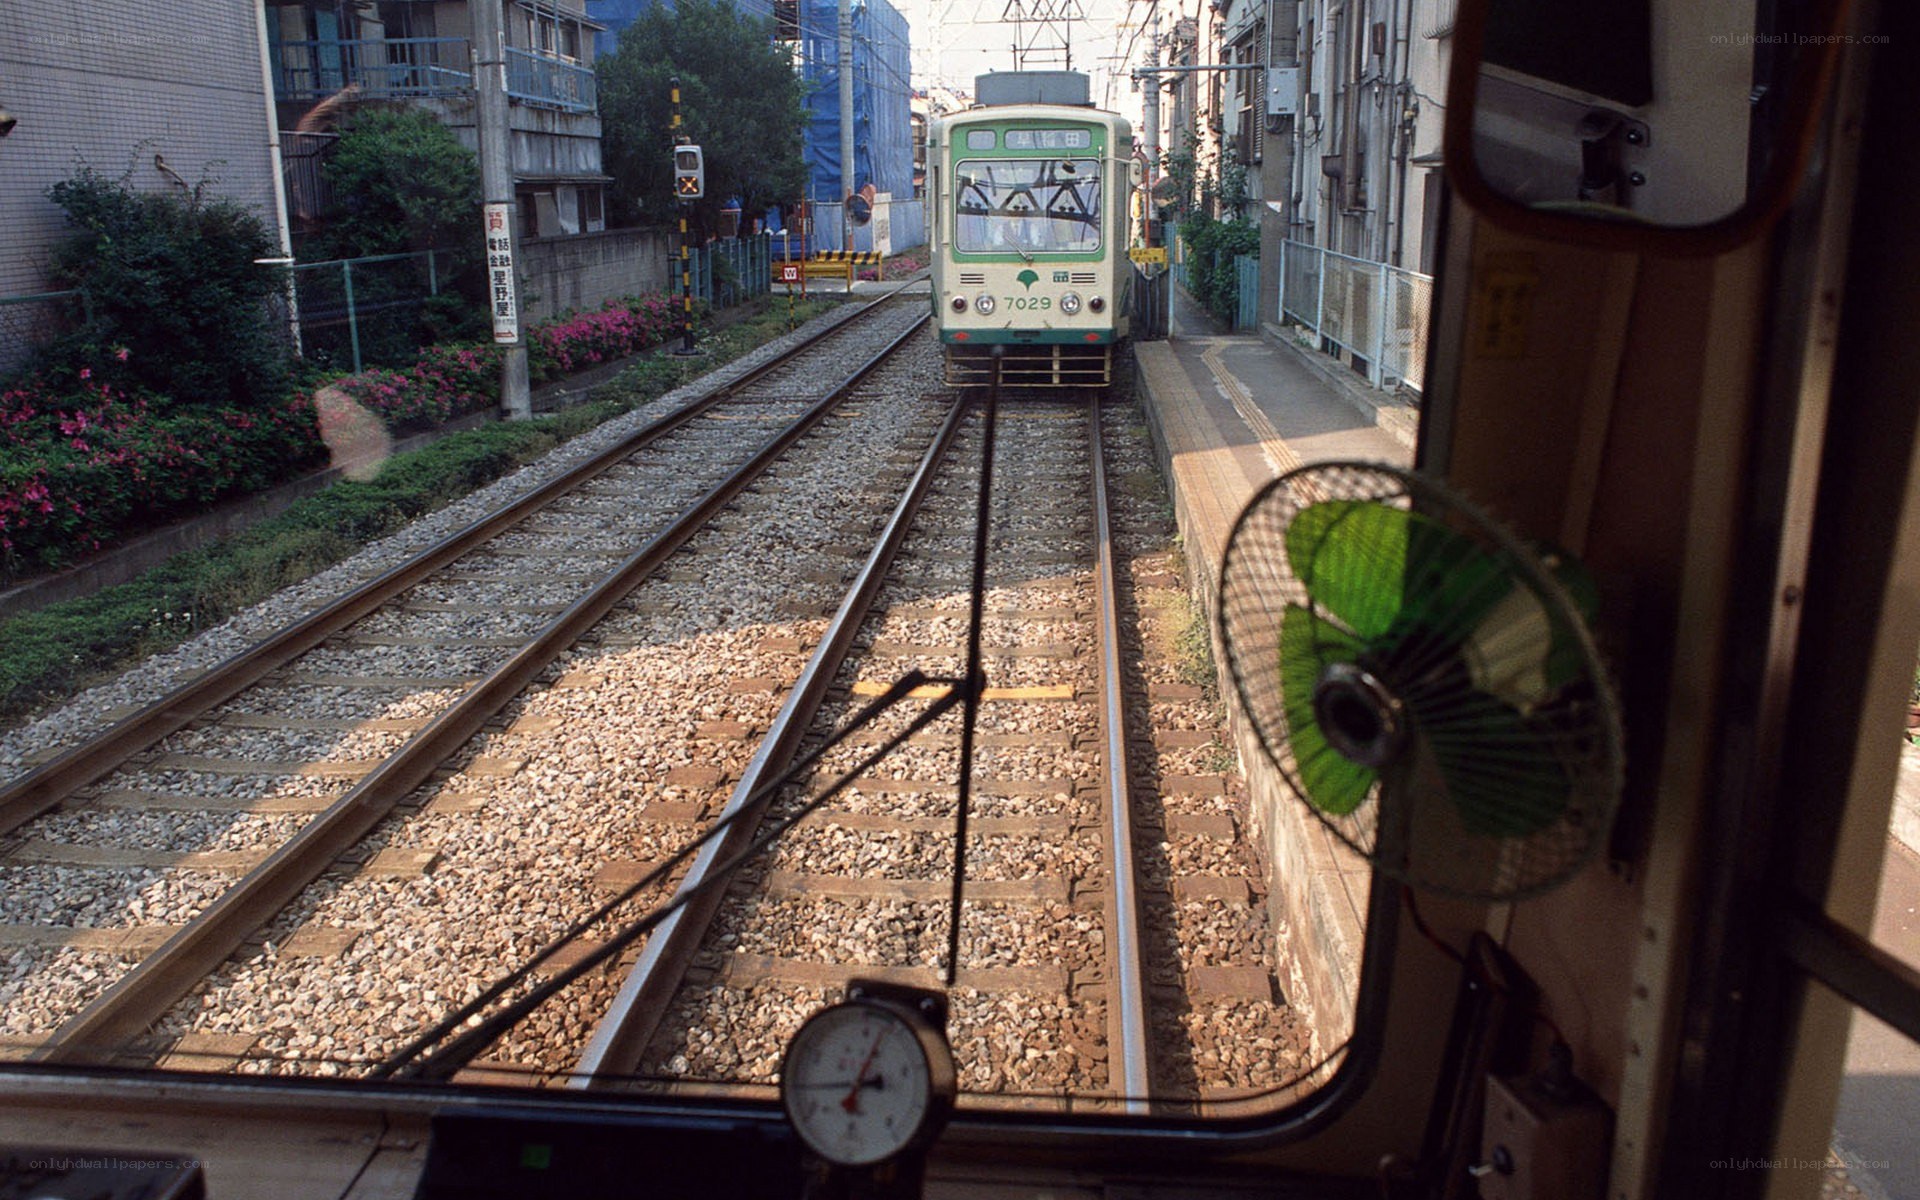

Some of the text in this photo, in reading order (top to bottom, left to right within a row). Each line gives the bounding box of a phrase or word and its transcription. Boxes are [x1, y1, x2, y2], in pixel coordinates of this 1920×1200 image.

[489, 211, 503, 232] 質
[489, 238, 509, 251] 電話
[490, 255, 511, 267] 金融
[785, 269, 795, 277] W
[494, 270, 509, 317] 星野屋
[1003, 296, 1051, 310] 7029
